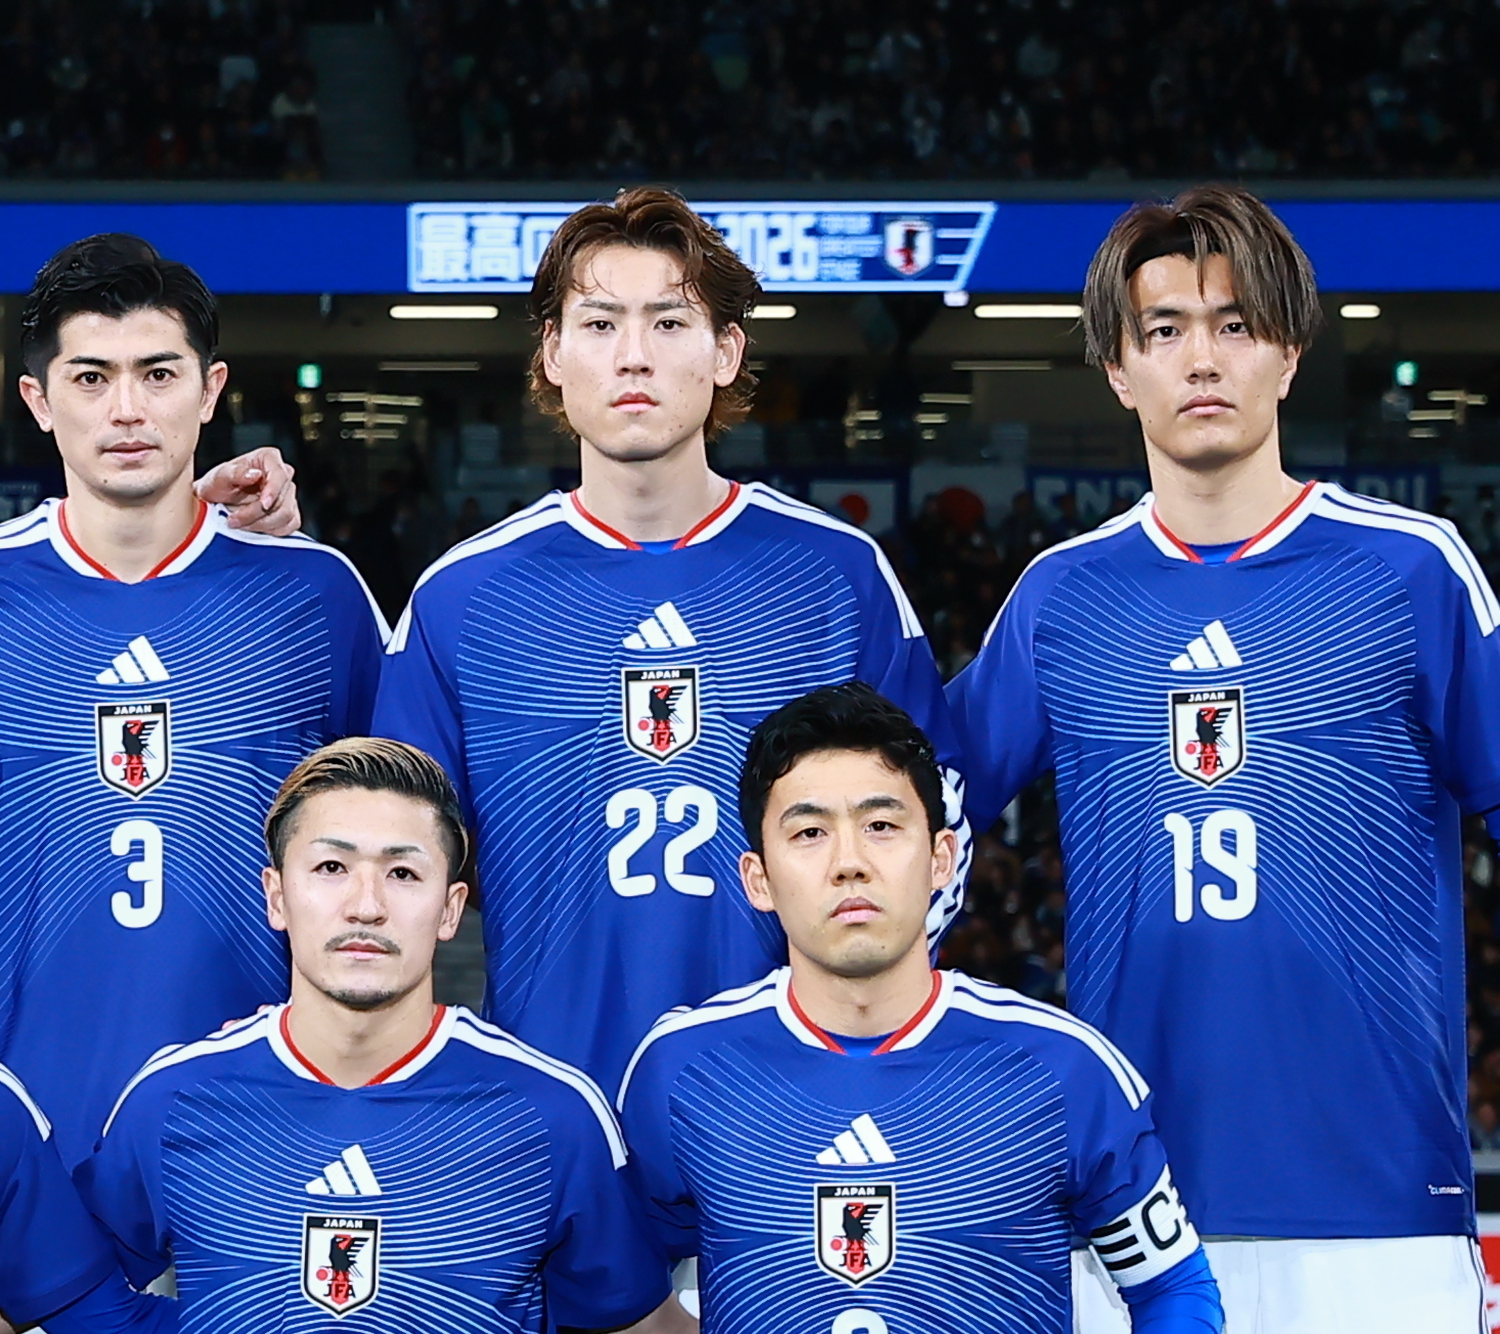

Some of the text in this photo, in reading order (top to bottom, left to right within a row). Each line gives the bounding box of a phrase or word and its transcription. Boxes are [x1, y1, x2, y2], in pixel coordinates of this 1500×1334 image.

[641, 670, 680, 680] JAPAN
[1188, 692, 1225, 703] JAPAN
[114, 705, 152, 715] JAPAN
[605, 785, 718, 898] 22
[1163, 808, 1257, 923] 19
[111, 820, 163, 928] 3
[834, 1187, 876, 1196] JAPAN
[323, 1219, 363, 1229] JAPAN
[1141, 1191, 1182, 1251] C
[838, 1253, 872, 1267] JFA
[323, 1283, 356, 1298] JFA
